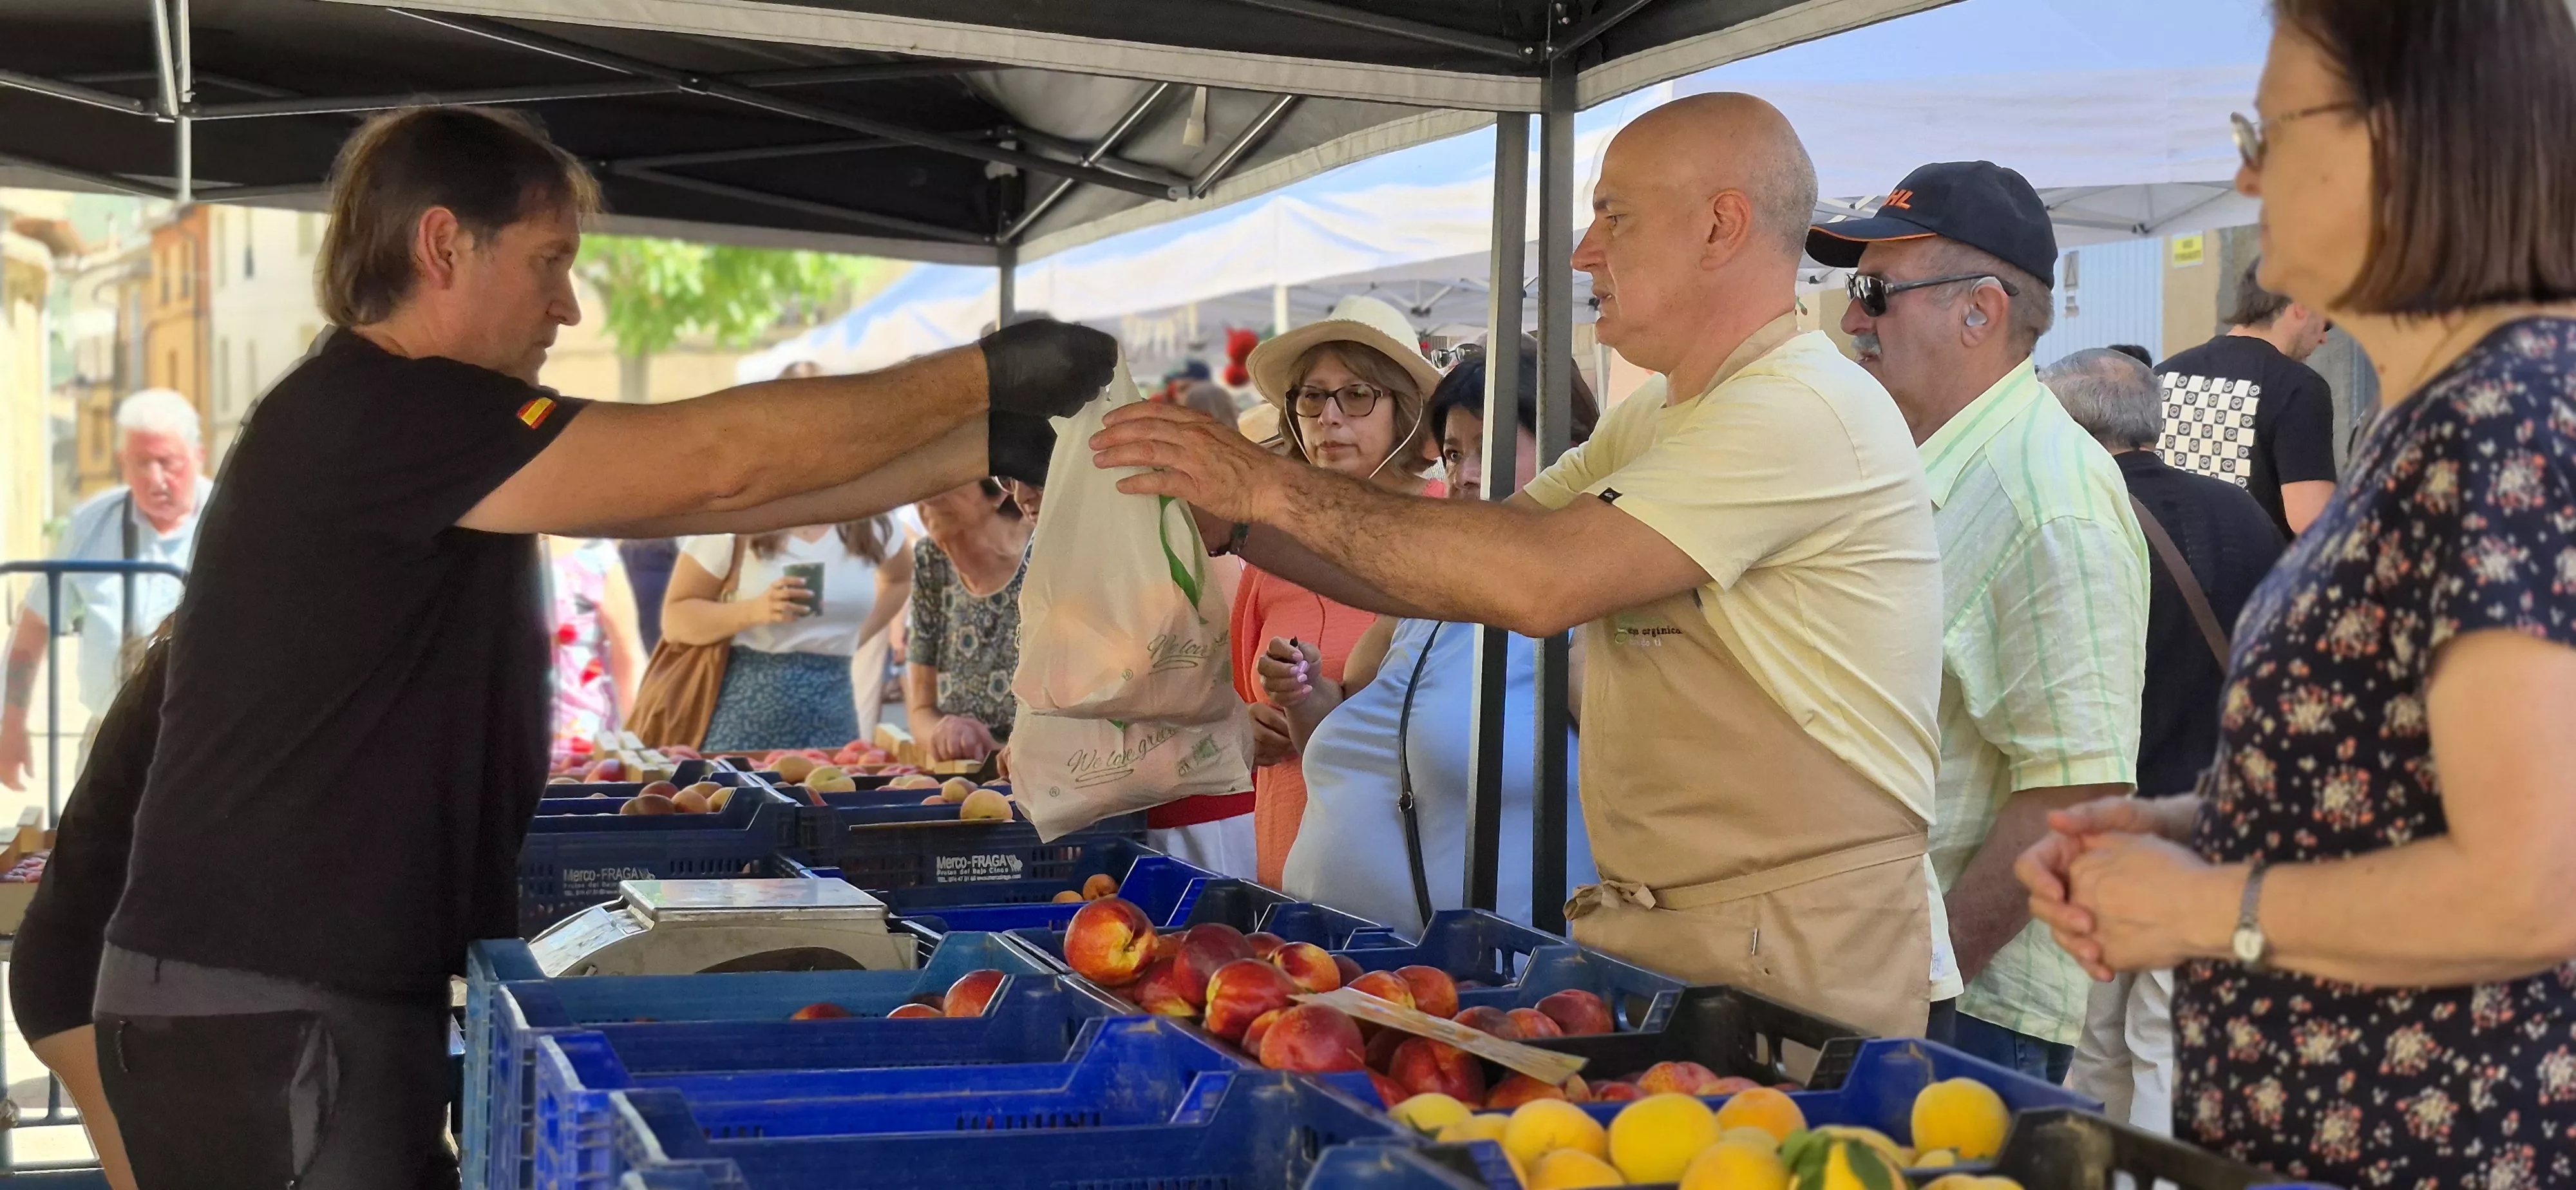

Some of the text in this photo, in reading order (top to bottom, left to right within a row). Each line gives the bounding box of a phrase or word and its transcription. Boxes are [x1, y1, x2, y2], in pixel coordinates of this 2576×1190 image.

[1068, 750, 1103, 773] We
[936, 854, 1007, 869] Merco-FRAGA
[564, 867, 639, 882] Merco-FRAGA
